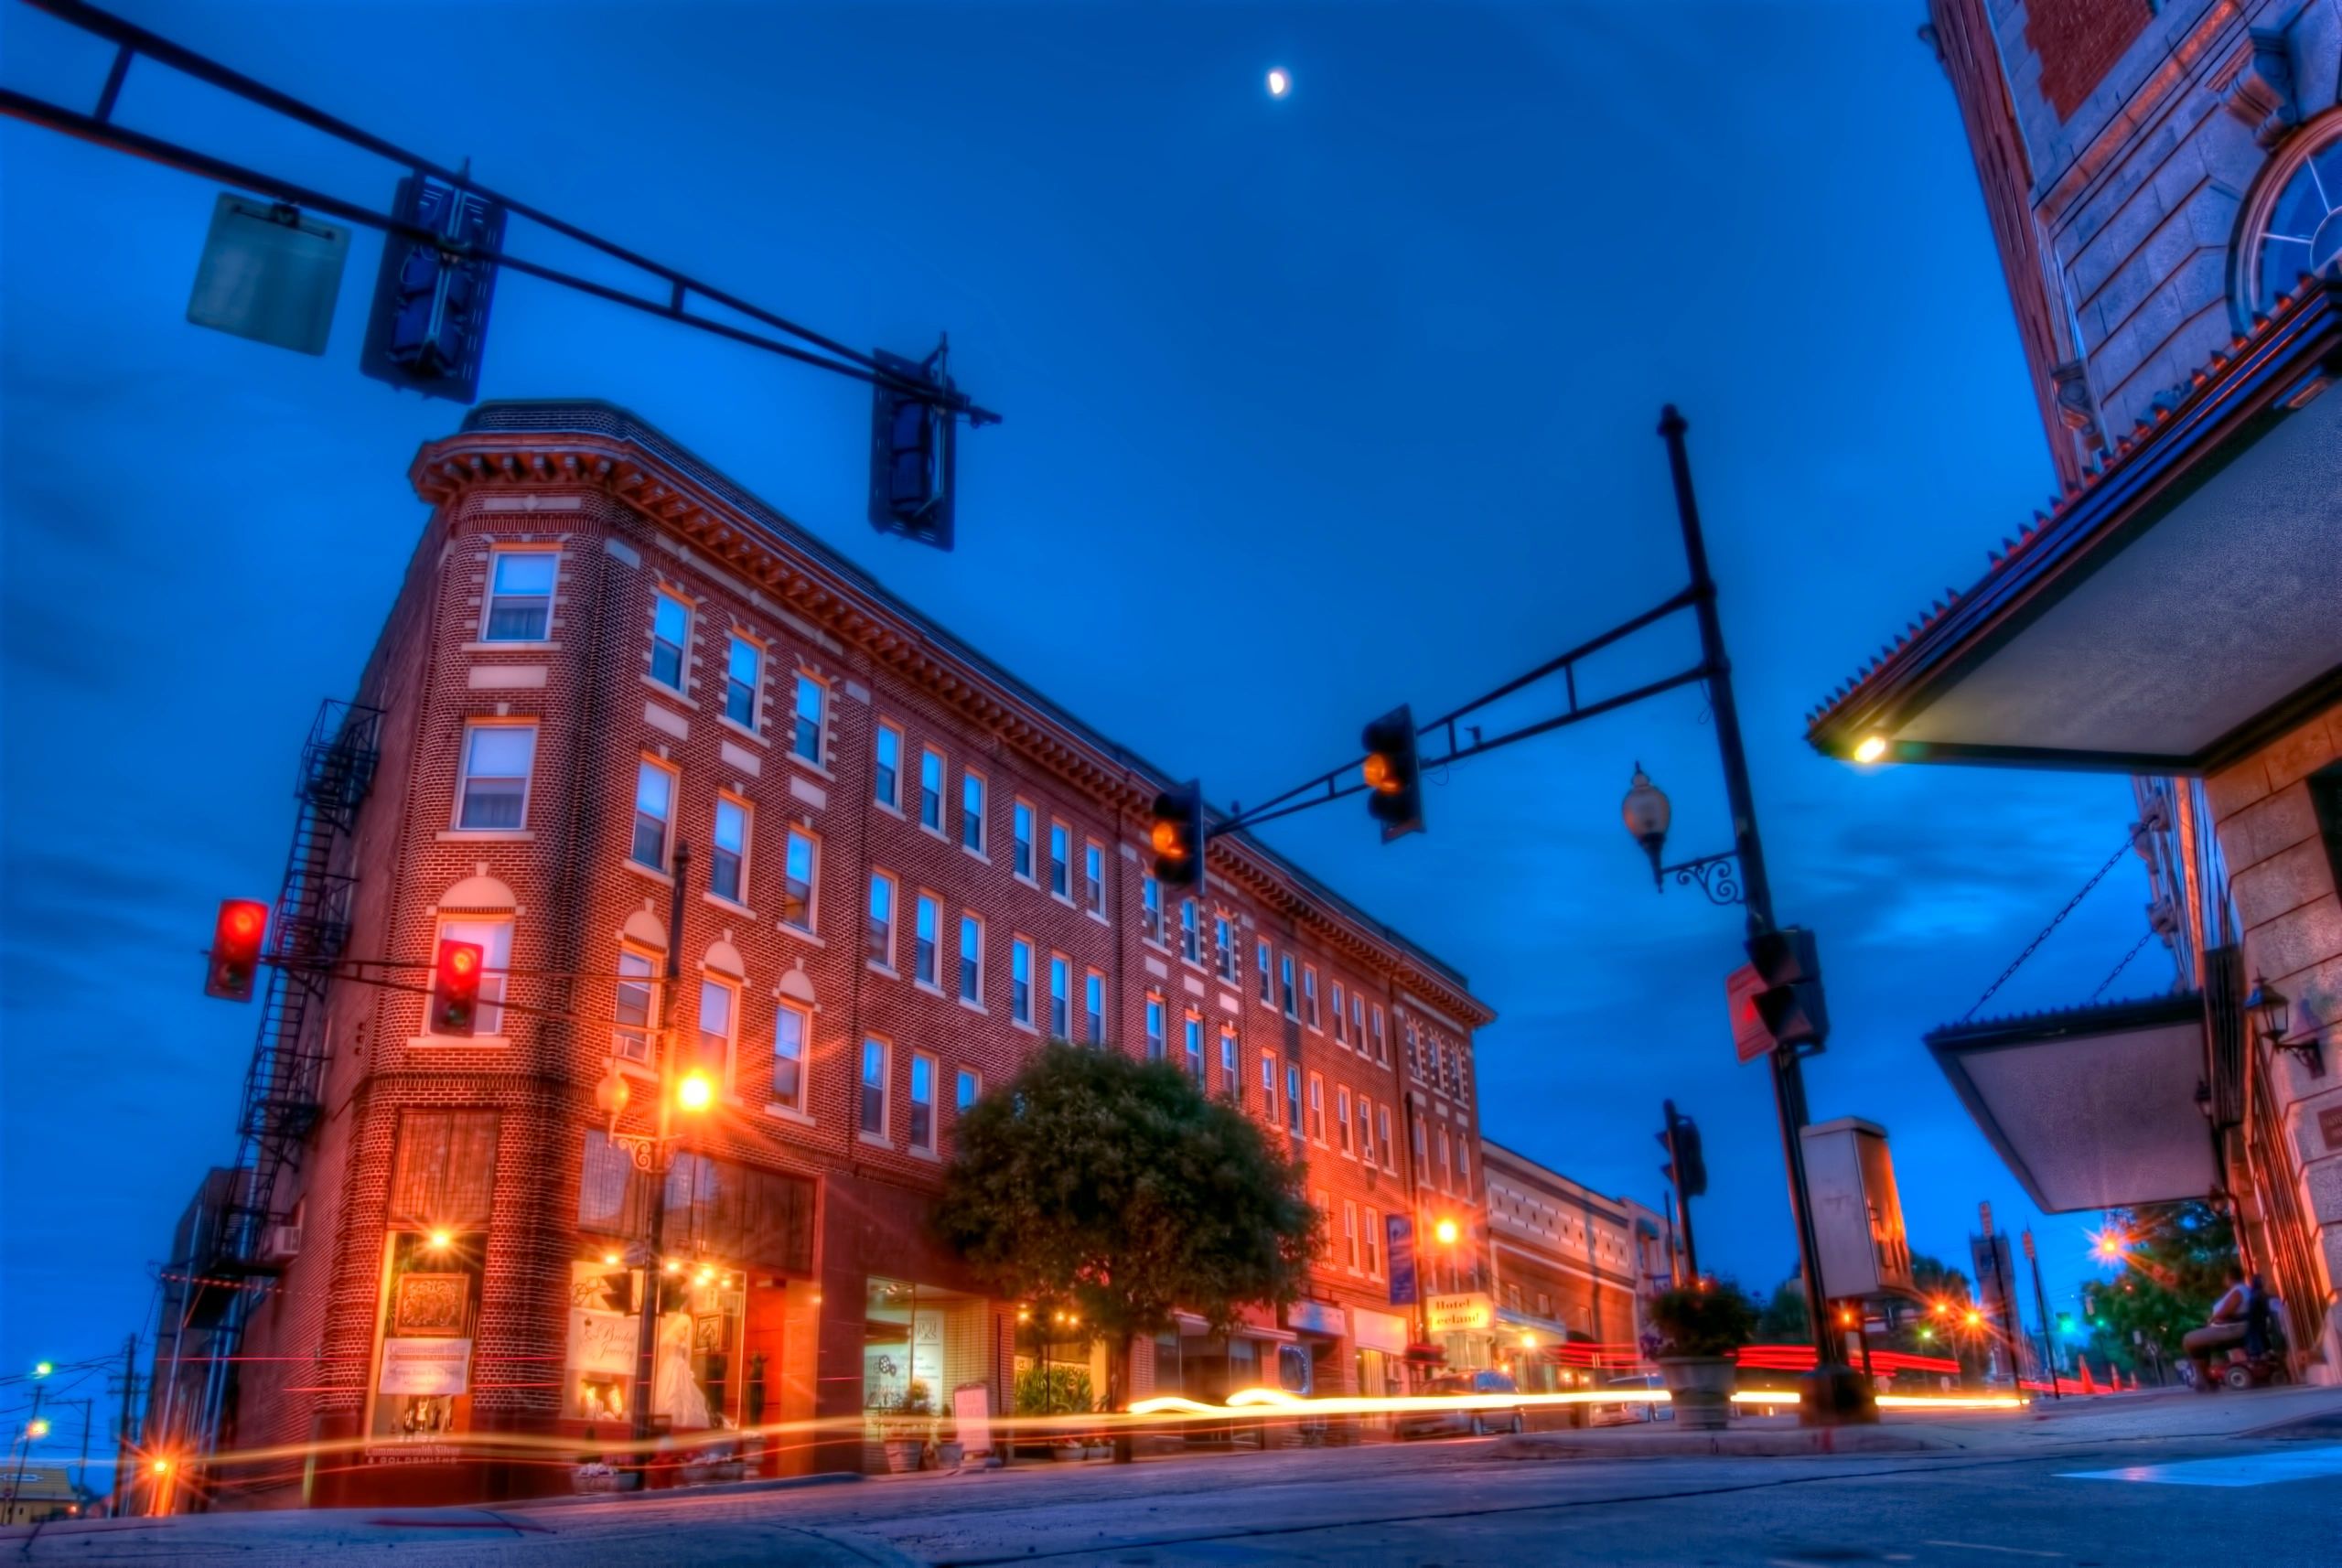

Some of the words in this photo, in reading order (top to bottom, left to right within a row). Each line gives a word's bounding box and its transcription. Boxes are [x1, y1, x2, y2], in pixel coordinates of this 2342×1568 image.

[1435, 1299, 1470, 1310] Hotel
[1431, 1313, 1479, 1325] eeland
[597, 1323, 638, 1342] Bridal
[435, 1444, 460, 1456] Silver
